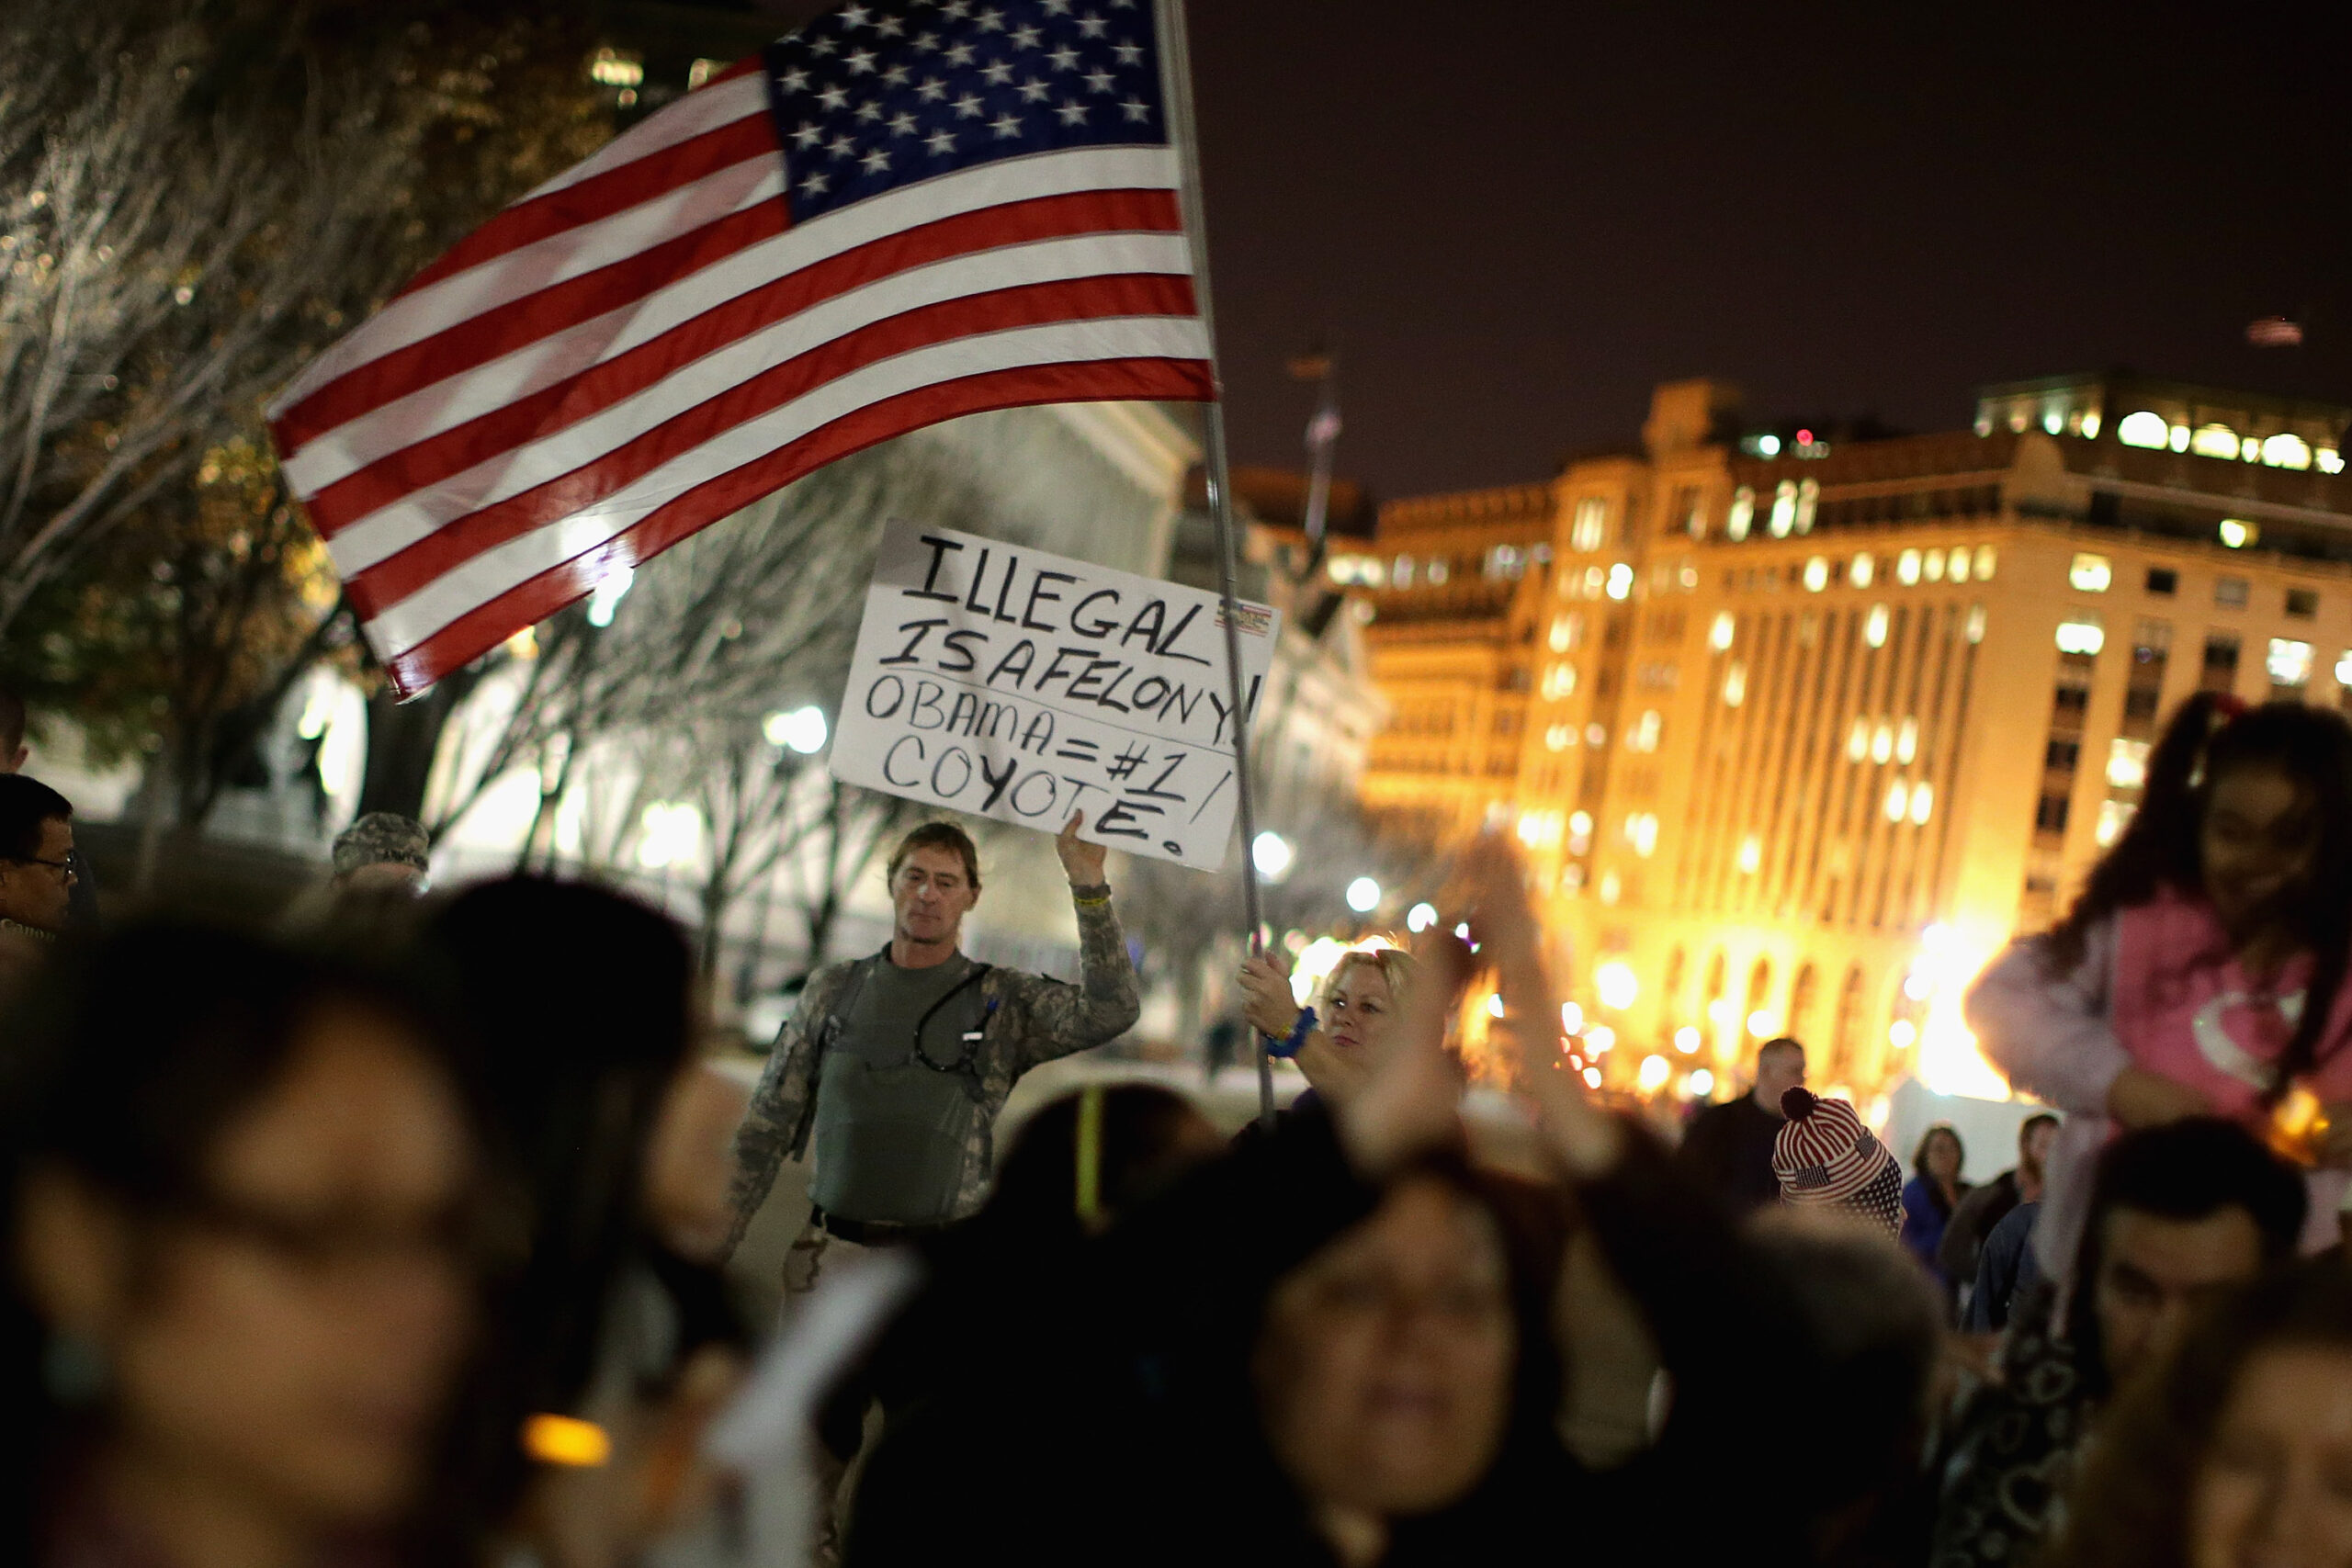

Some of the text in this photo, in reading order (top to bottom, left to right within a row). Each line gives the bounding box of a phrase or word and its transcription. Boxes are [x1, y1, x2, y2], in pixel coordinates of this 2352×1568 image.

[902, 536, 1212, 667] ILLEGAL
[879, 618, 989, 671] IS
[986, 639, 1035, 691] A
